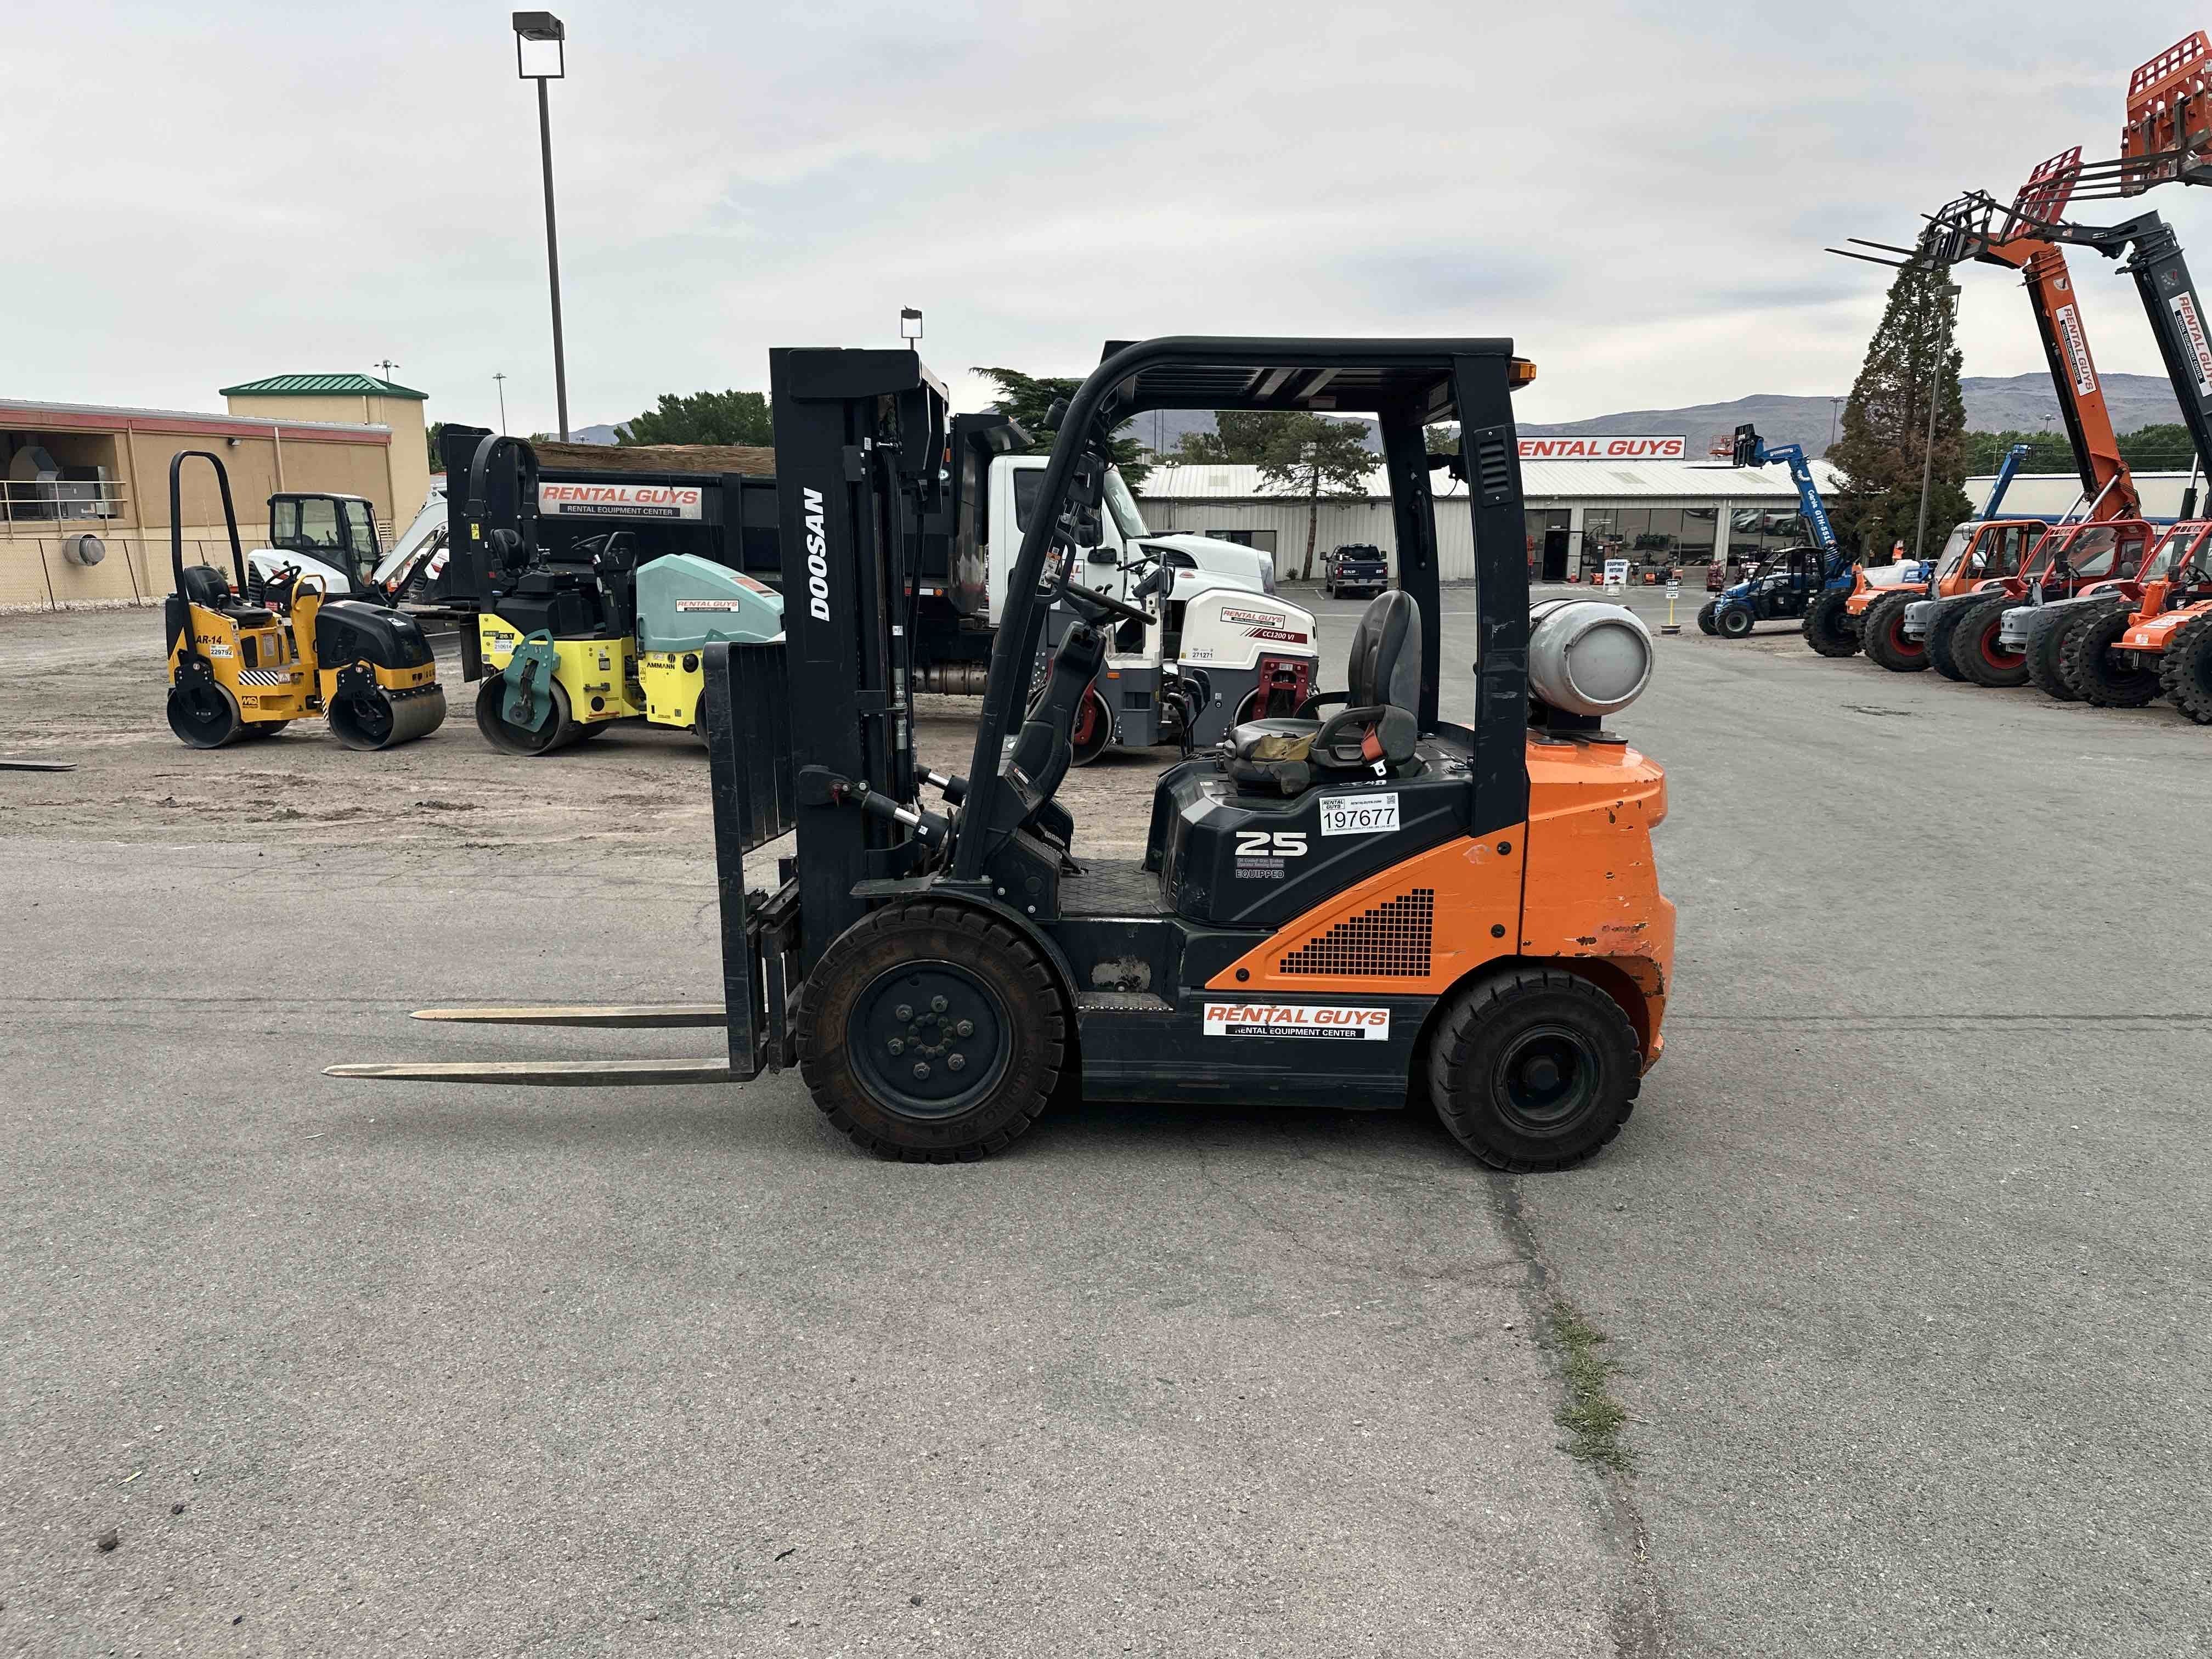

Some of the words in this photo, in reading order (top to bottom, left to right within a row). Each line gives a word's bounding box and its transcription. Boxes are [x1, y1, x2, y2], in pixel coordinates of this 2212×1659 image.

[2179, 297, 2204, 350] RENTAL
[2064, 308, 2084, 356] RENTAL
[2079, 357, 2093, 390] GUYS
[2193, 359, 2202, 380] CENTER
[1518, 441, 1601, 456] ENTAL
[1607, 440, 1683, 456] GUYS
[543, 486, 630, 503] RENTAL
[635, 488, 698, 504] GUYS
[597, 506, 641, 515] EQUIPMENT
[803, 487, 830, 622] DOOSAN
[1223, 610, 1257, 619] RENTAL
[196, 635, 222, 644] AR-14
[1262, 631, 1286, 639] CC1200
[1324, 808, 1395, 828] 197677
[1235, 831, 1308, 856] 25
[1235, 869, 1284, 878] EQUIPPED
[1206, 1007, 1308, 1023] RENTAL
[1314, 1010, 1387, 1025] GUYS
[1270, 1028, 1321, 1036] EQUIPMENT
